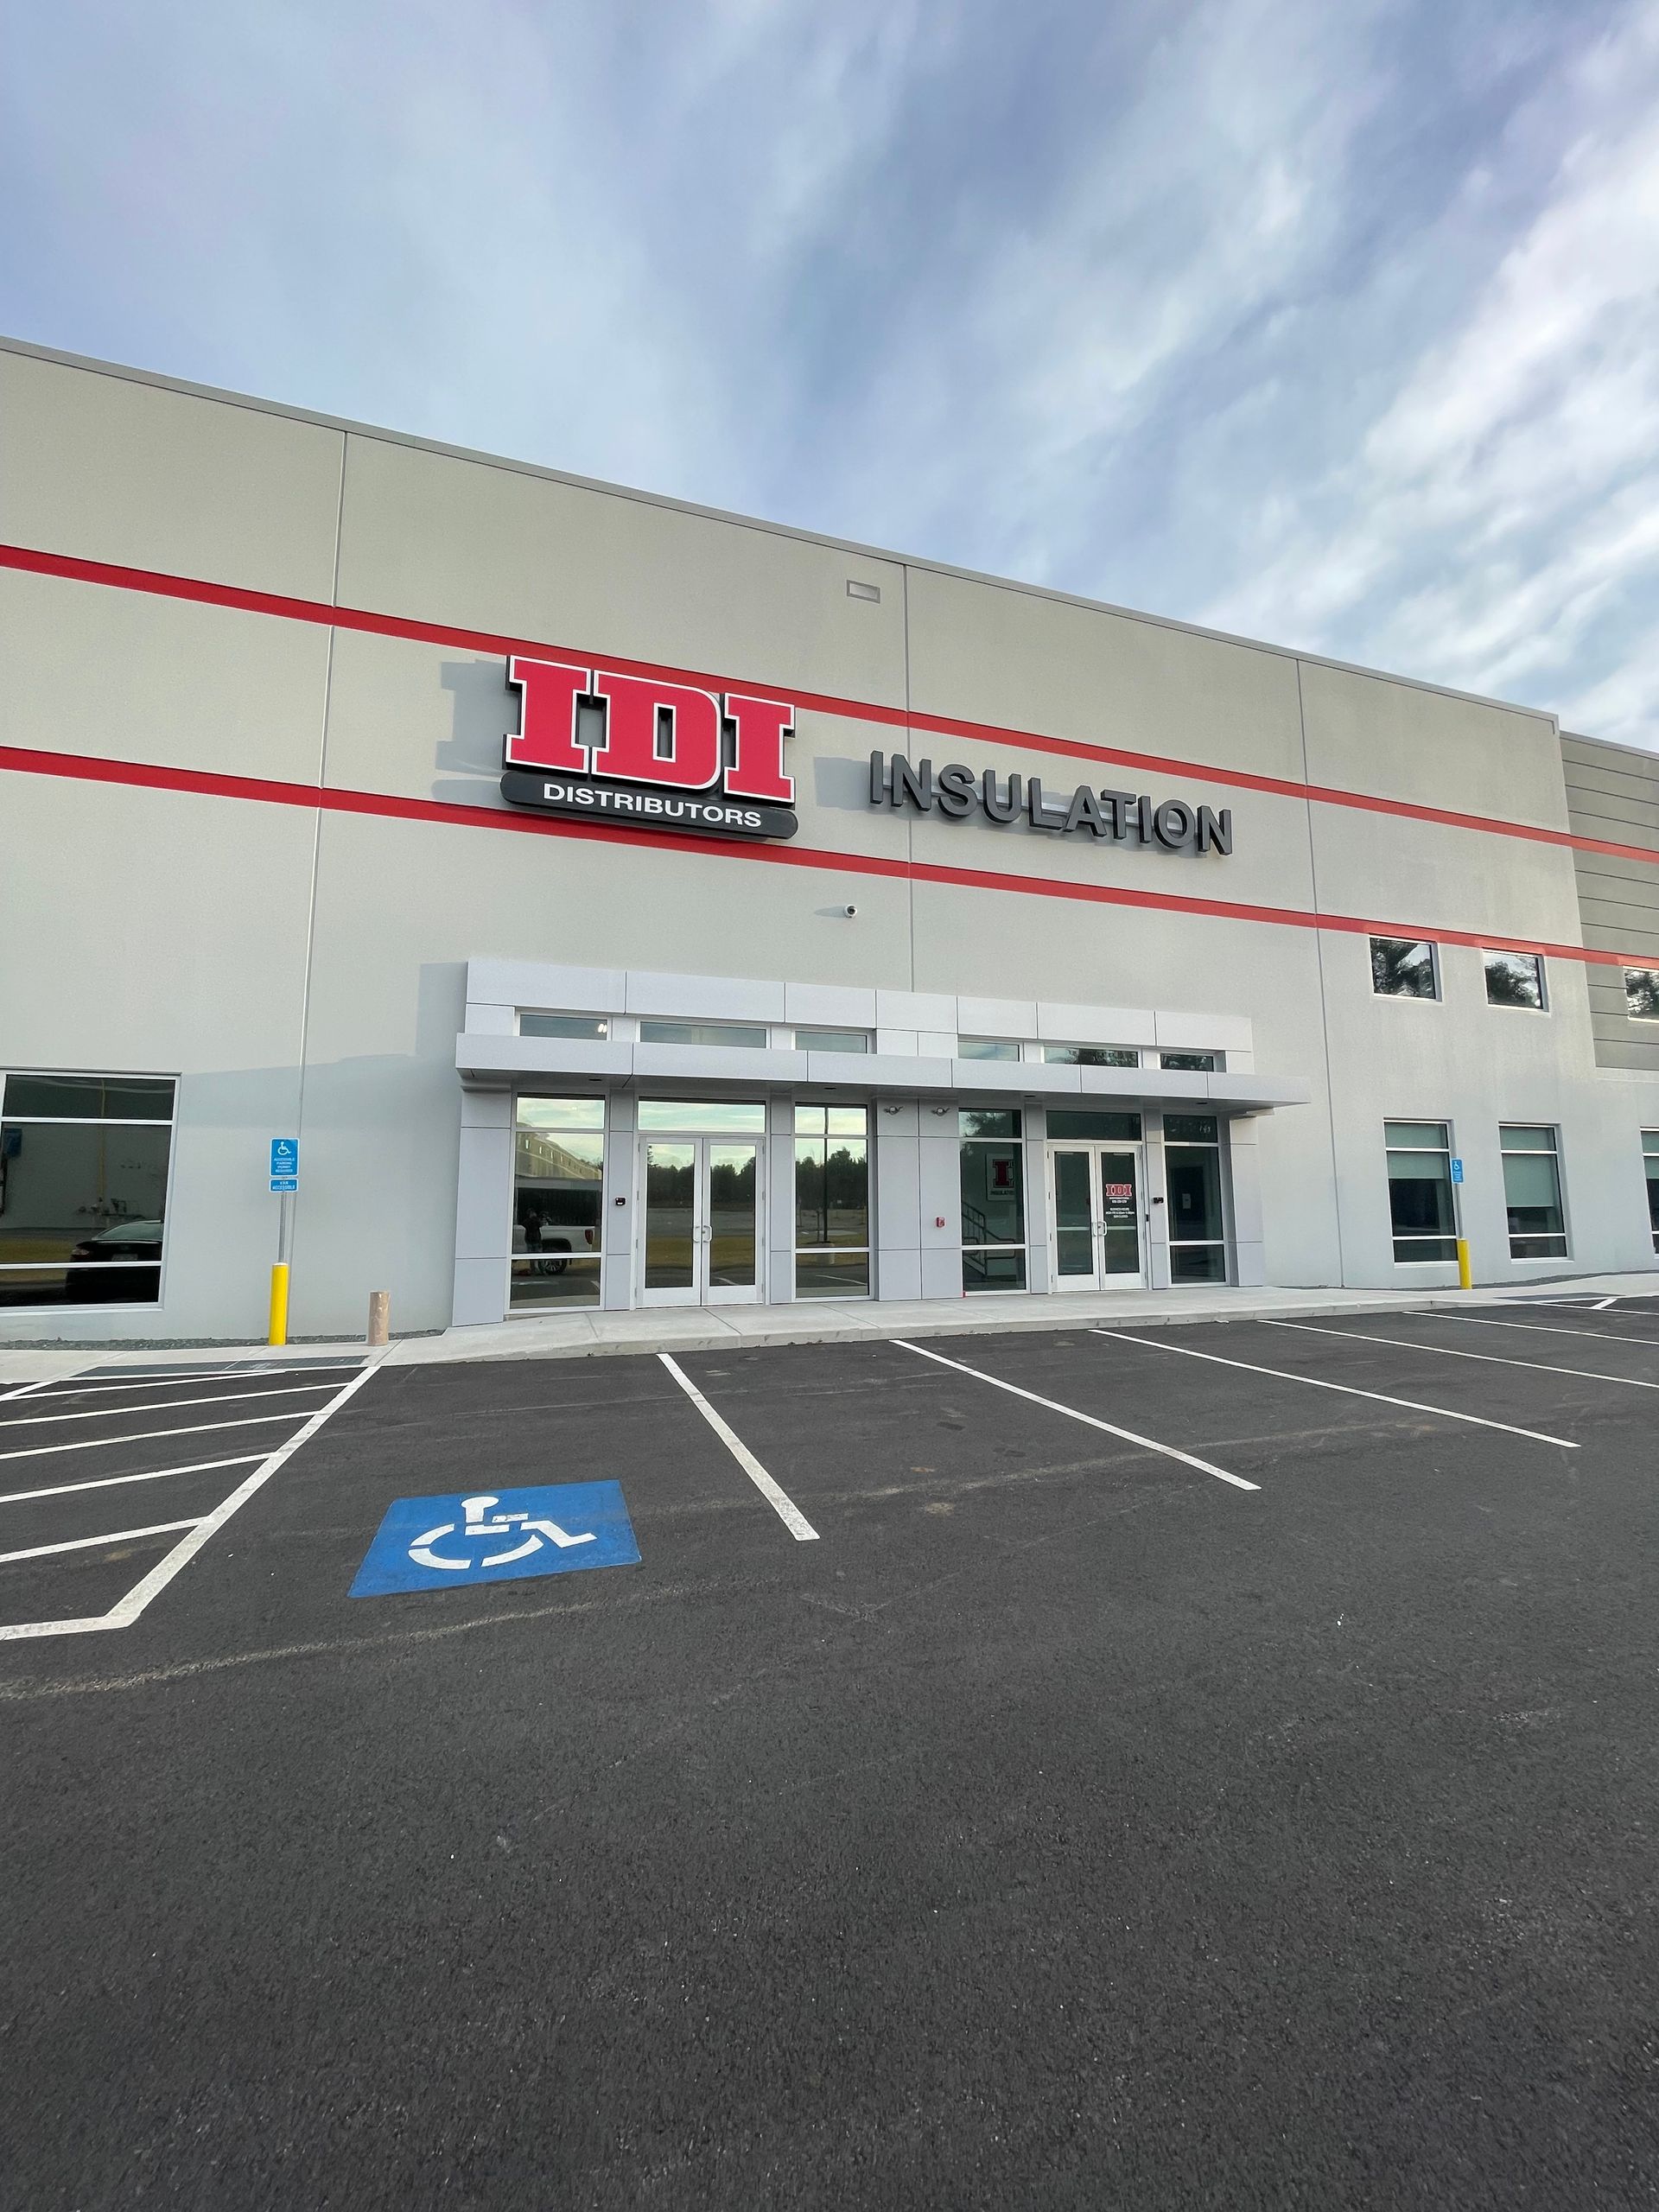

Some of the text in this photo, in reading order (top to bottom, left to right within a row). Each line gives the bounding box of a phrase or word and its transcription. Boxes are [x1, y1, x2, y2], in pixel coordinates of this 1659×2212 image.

[505, 654, 796, 804] IDI
[543, 783, 762, 829] DISTRIBUTORS
[869, 750, 1233, 855] INSULATION
[1106, 1184, 1132, 1197] IDI
